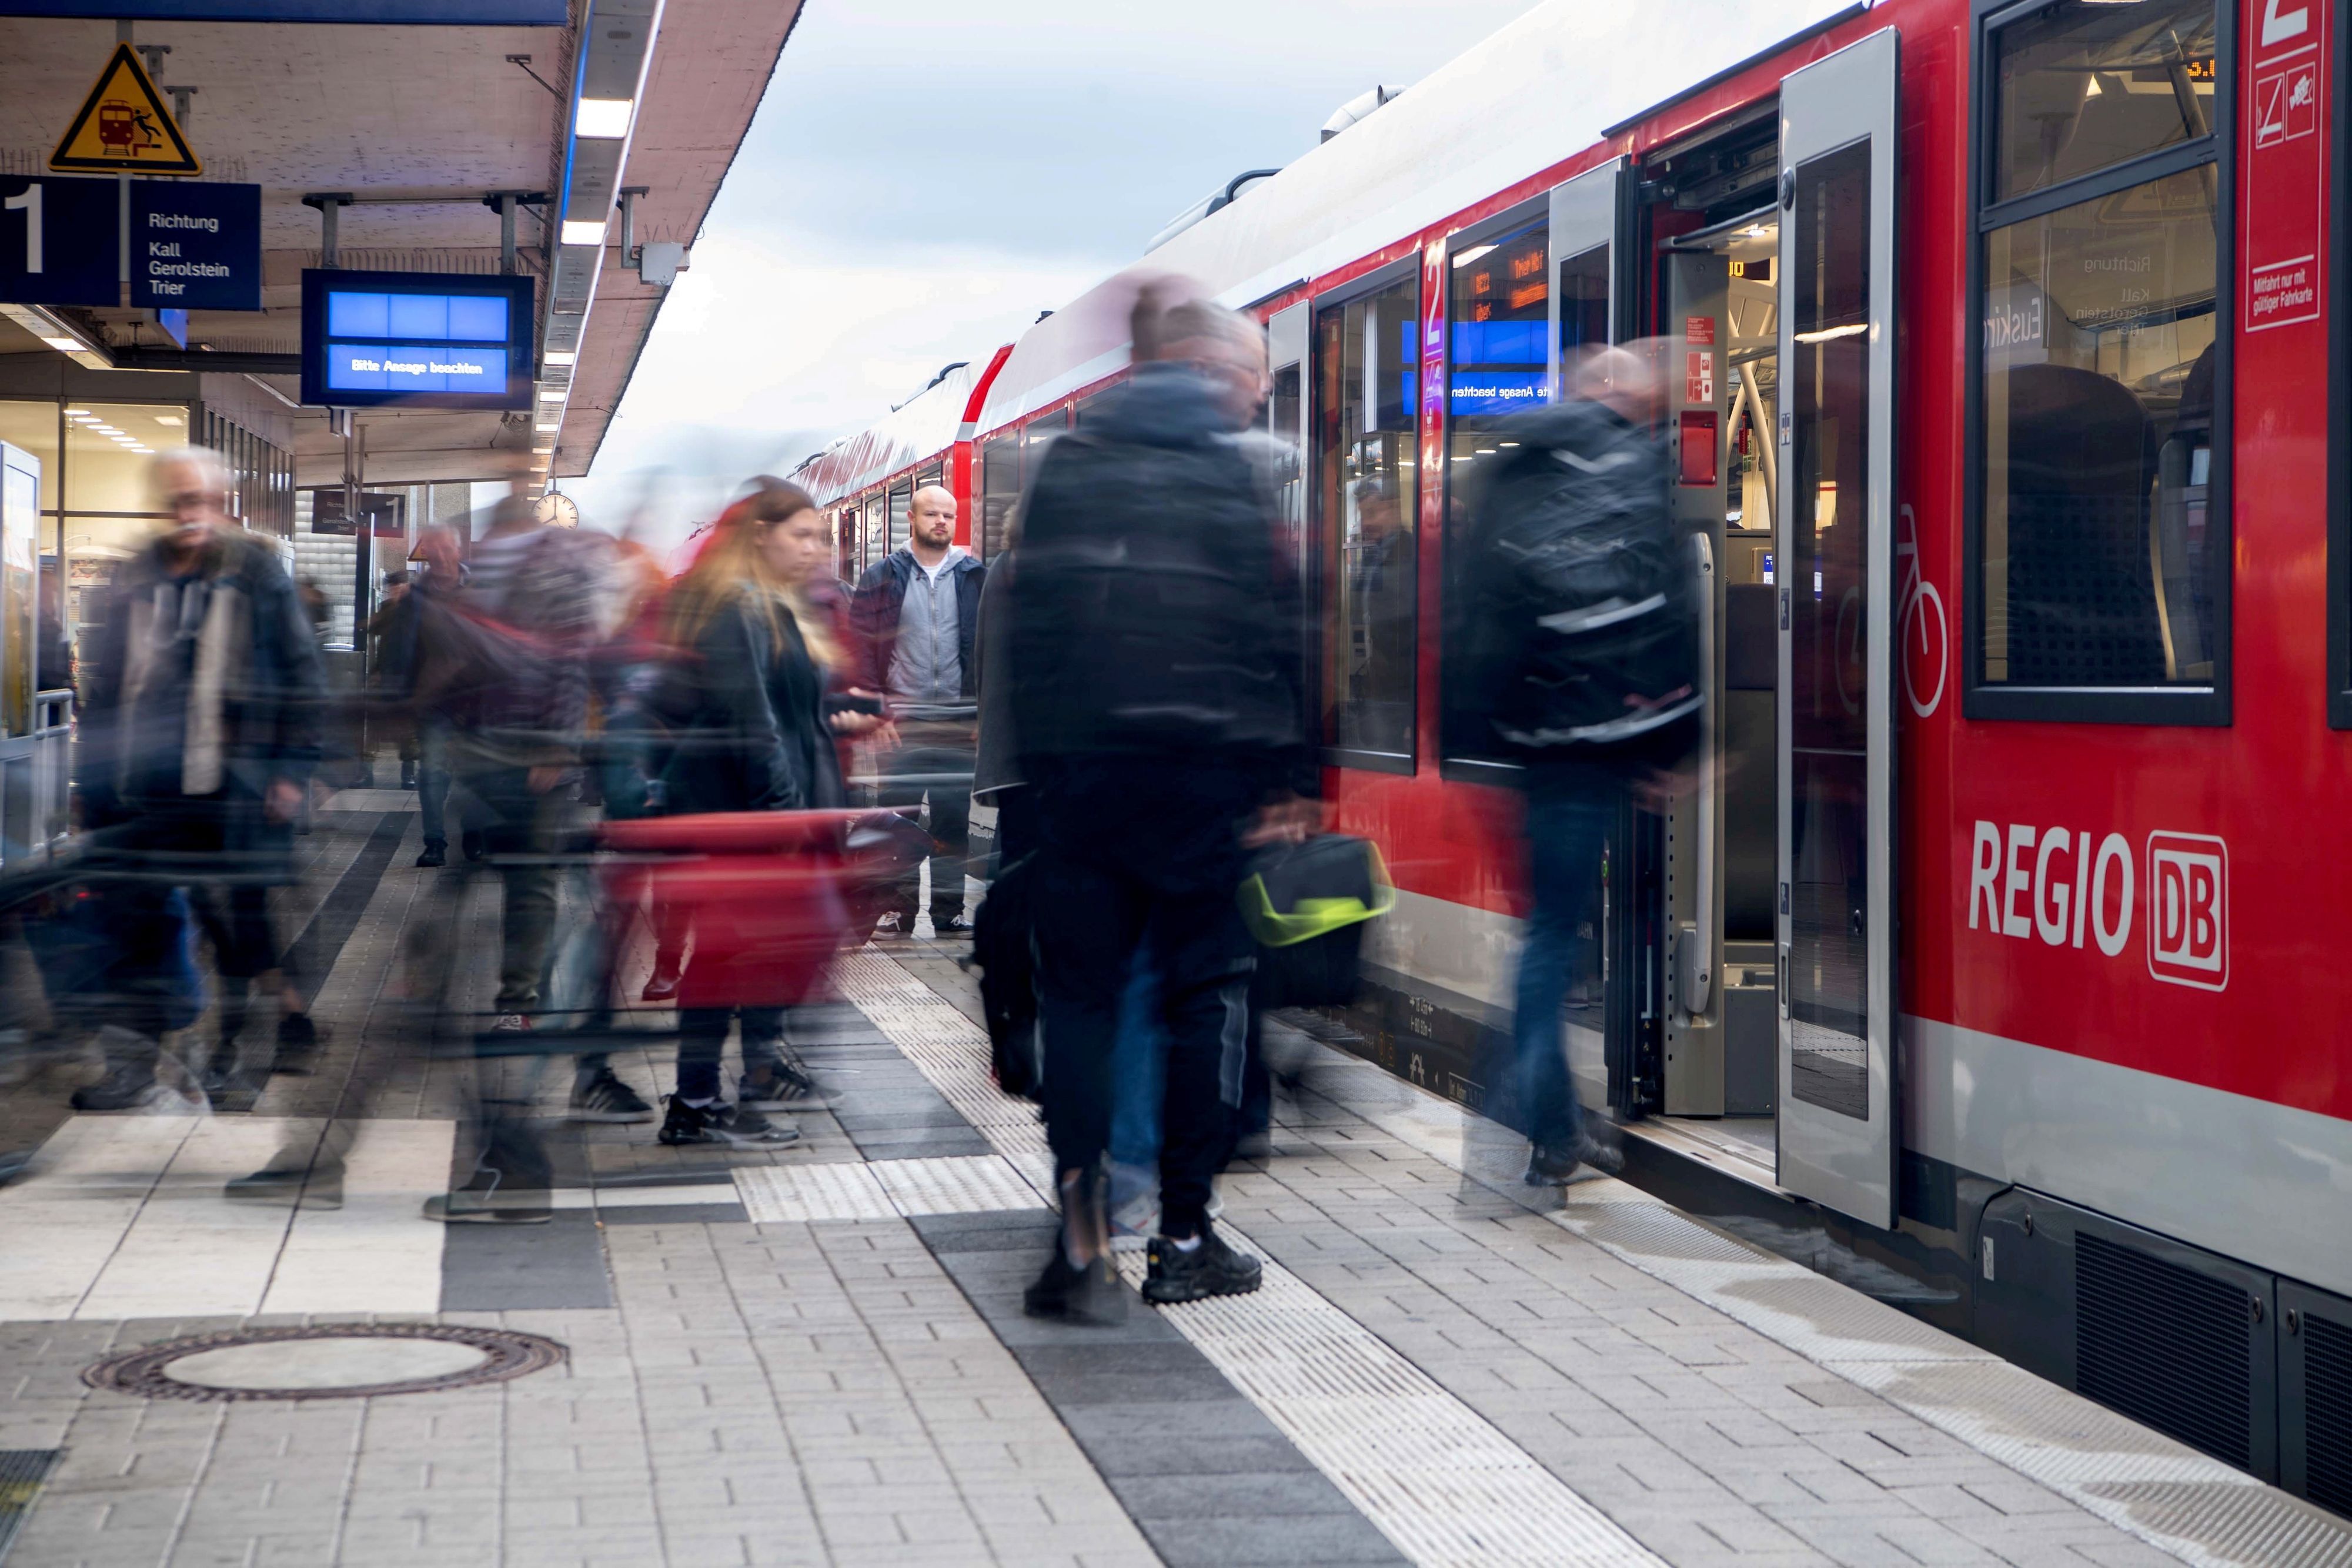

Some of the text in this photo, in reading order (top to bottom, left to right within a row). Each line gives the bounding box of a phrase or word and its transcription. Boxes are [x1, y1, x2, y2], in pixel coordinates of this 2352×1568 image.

[4, 183, 43, 273] 1
[149, 213, 219, 233] Richtung
[149, 242, 181, 257] Kall
[149, 260, 230, 277] Gerolstein
[2254, 268, 2306, 295] Mitfahrt nur mit
[149, 280, 186, 295] Trier
[1426, 260, 1441, 346] 2
[2253, 287, 2313, 317] gültiger Fahrkarte
[352, 359, 483, 375] Bitte Ansage beachten
[385, 497, 399, 528] 1
[1969, 820, 2219, 964] REGIO DB
